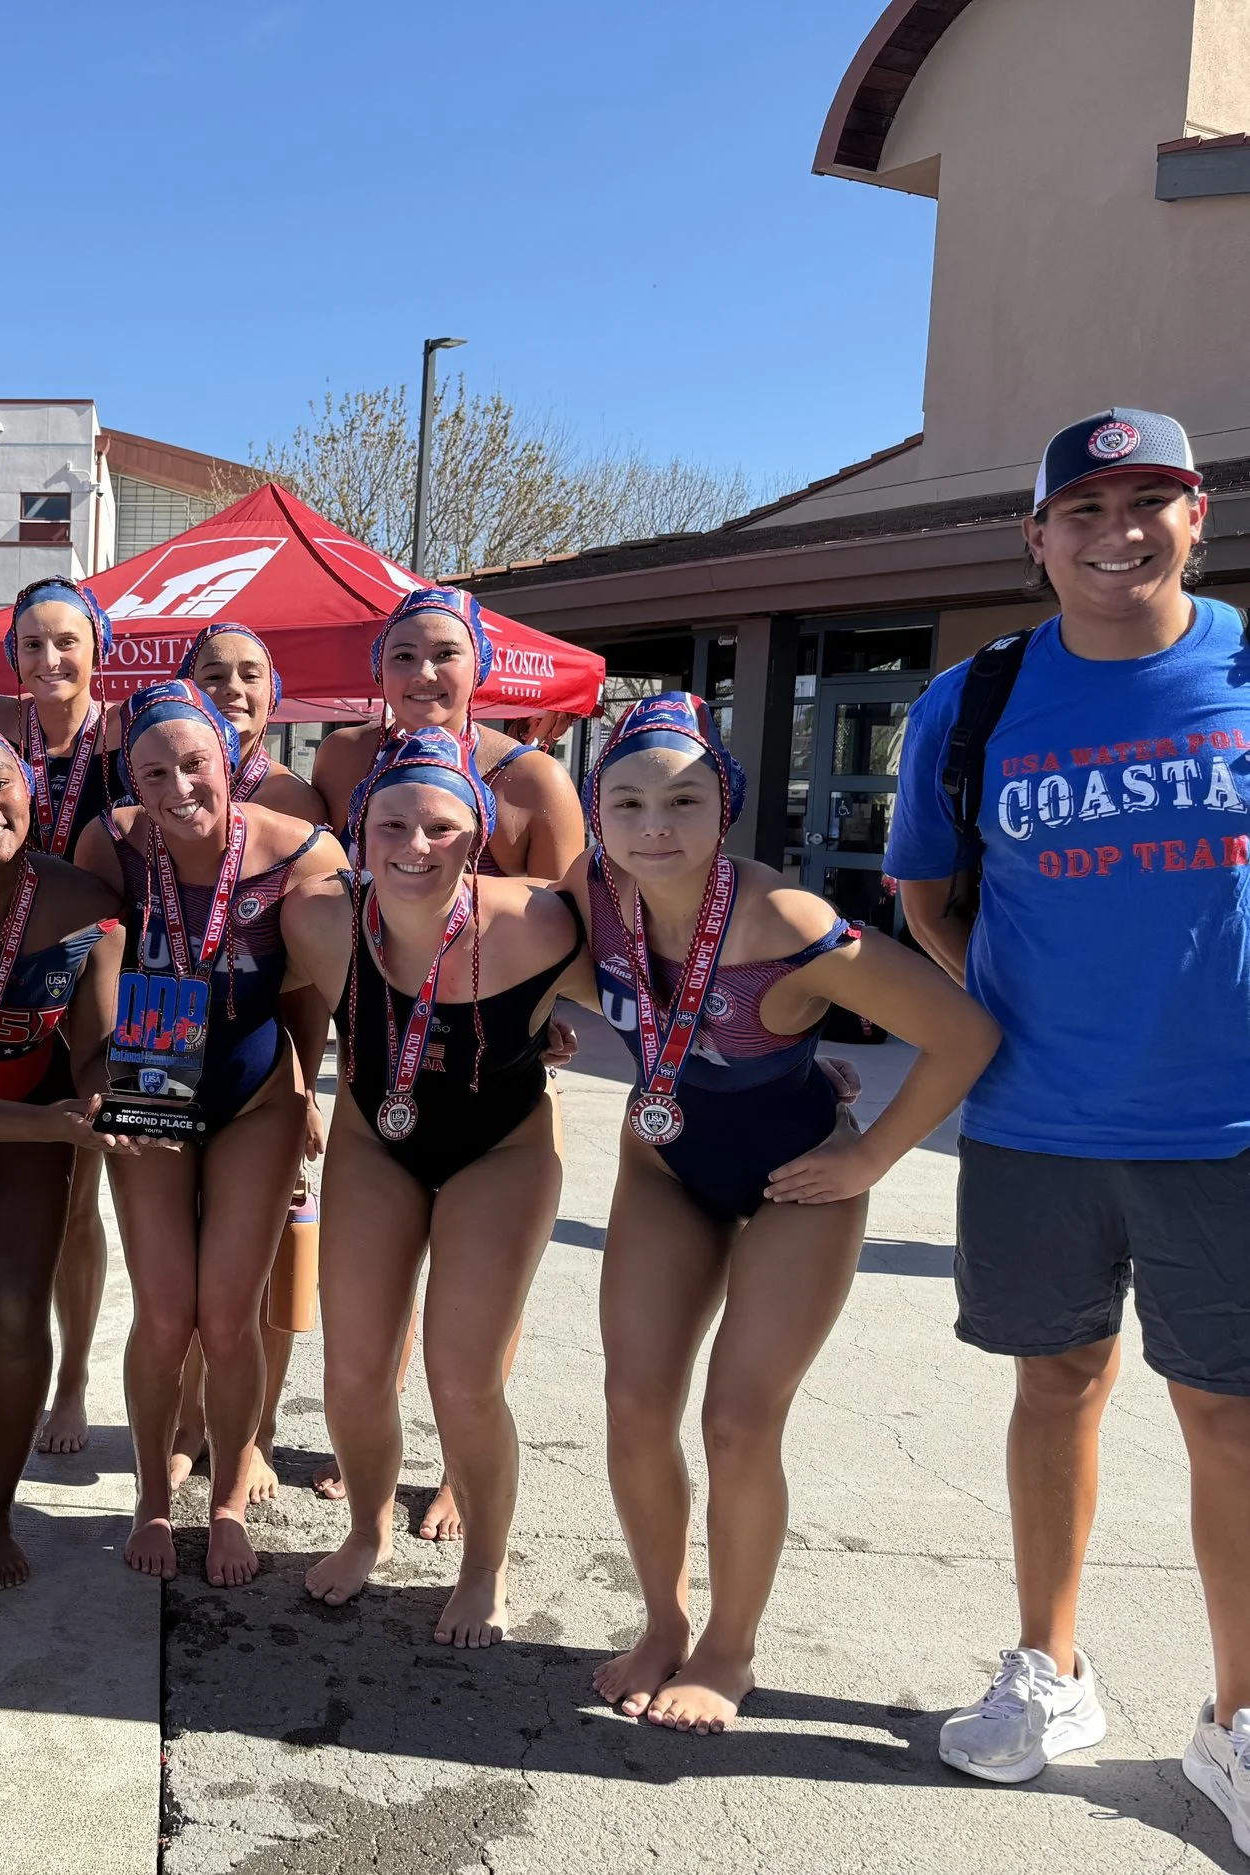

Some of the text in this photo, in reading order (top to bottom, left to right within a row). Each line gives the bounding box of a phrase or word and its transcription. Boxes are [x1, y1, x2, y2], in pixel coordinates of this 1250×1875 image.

[103, 639, 193, 665] POSITA
[506, 648, 555, 678] POSITAS
[501, 685, 542, 698] COLLEGE
[1002, 752, 1061, 777] USA
[1070, 737, 1178, 768] WATER
[34, 765, 48, 807] PROGRAM
[58, 800, 75, 837] OLYMPIC
[68, 738, 93, 797] DEVELOPMENT
[233, 753, 269, 802] EVELOPMENT
[998, 756, 1250, 841] COASTA
[1039, 845, 1122, 879] ODP
[159, 854, 180, 926] DEVELOPMENT
[6, 880, 34, 952] DEVELOPMENT
[208, 899, 227, 942] OLYMPIC
[48, 976, 67, 985] USA
[600, 960, 632, 980] Delfina
[689, 940, 715, 990] OLYMPIC
[401, 1033, 421, 1078] OLYMPIC
[144, 1075, 161, 1084] USA
[660, 1068, 675, 1077] USA
[386, 1096, 413, 1109] OLYMPIC
[638, 1097, 676, 1112] OLYMPIC
[647, 1114, 664, 1123] USA
[115, 1114, 193, 1130] SECOND PLACE
